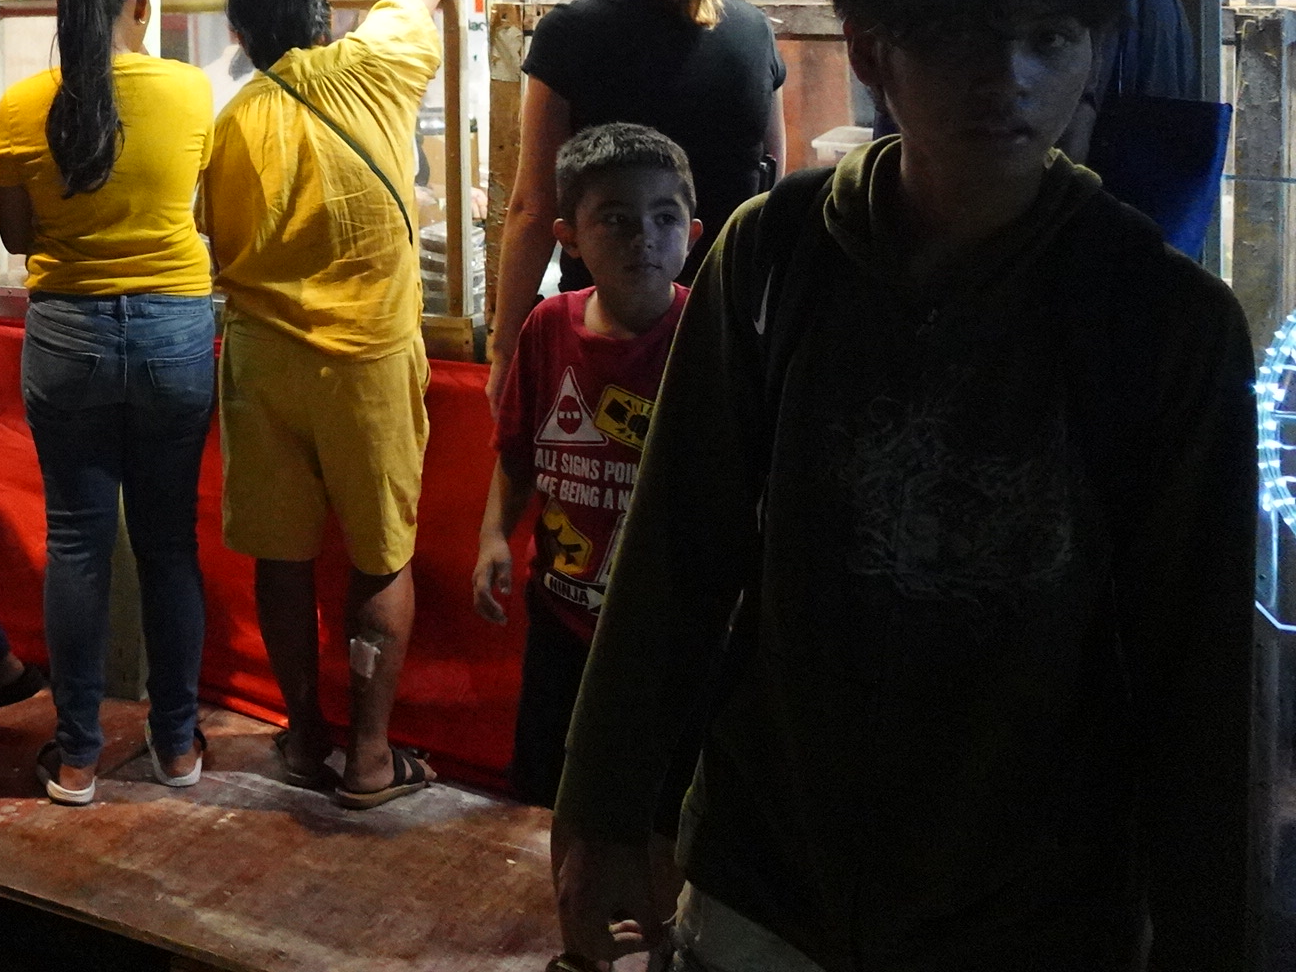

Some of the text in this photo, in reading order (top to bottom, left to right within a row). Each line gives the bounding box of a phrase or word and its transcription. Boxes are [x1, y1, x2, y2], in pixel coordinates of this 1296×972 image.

[534, 448, 558, 472] ALL
[561, 452, 601, 480] SIGNS
[536, 473, 558, 498] ME
[559, 481, 599, 508] BEING
[603, 488, 613, 509] A
